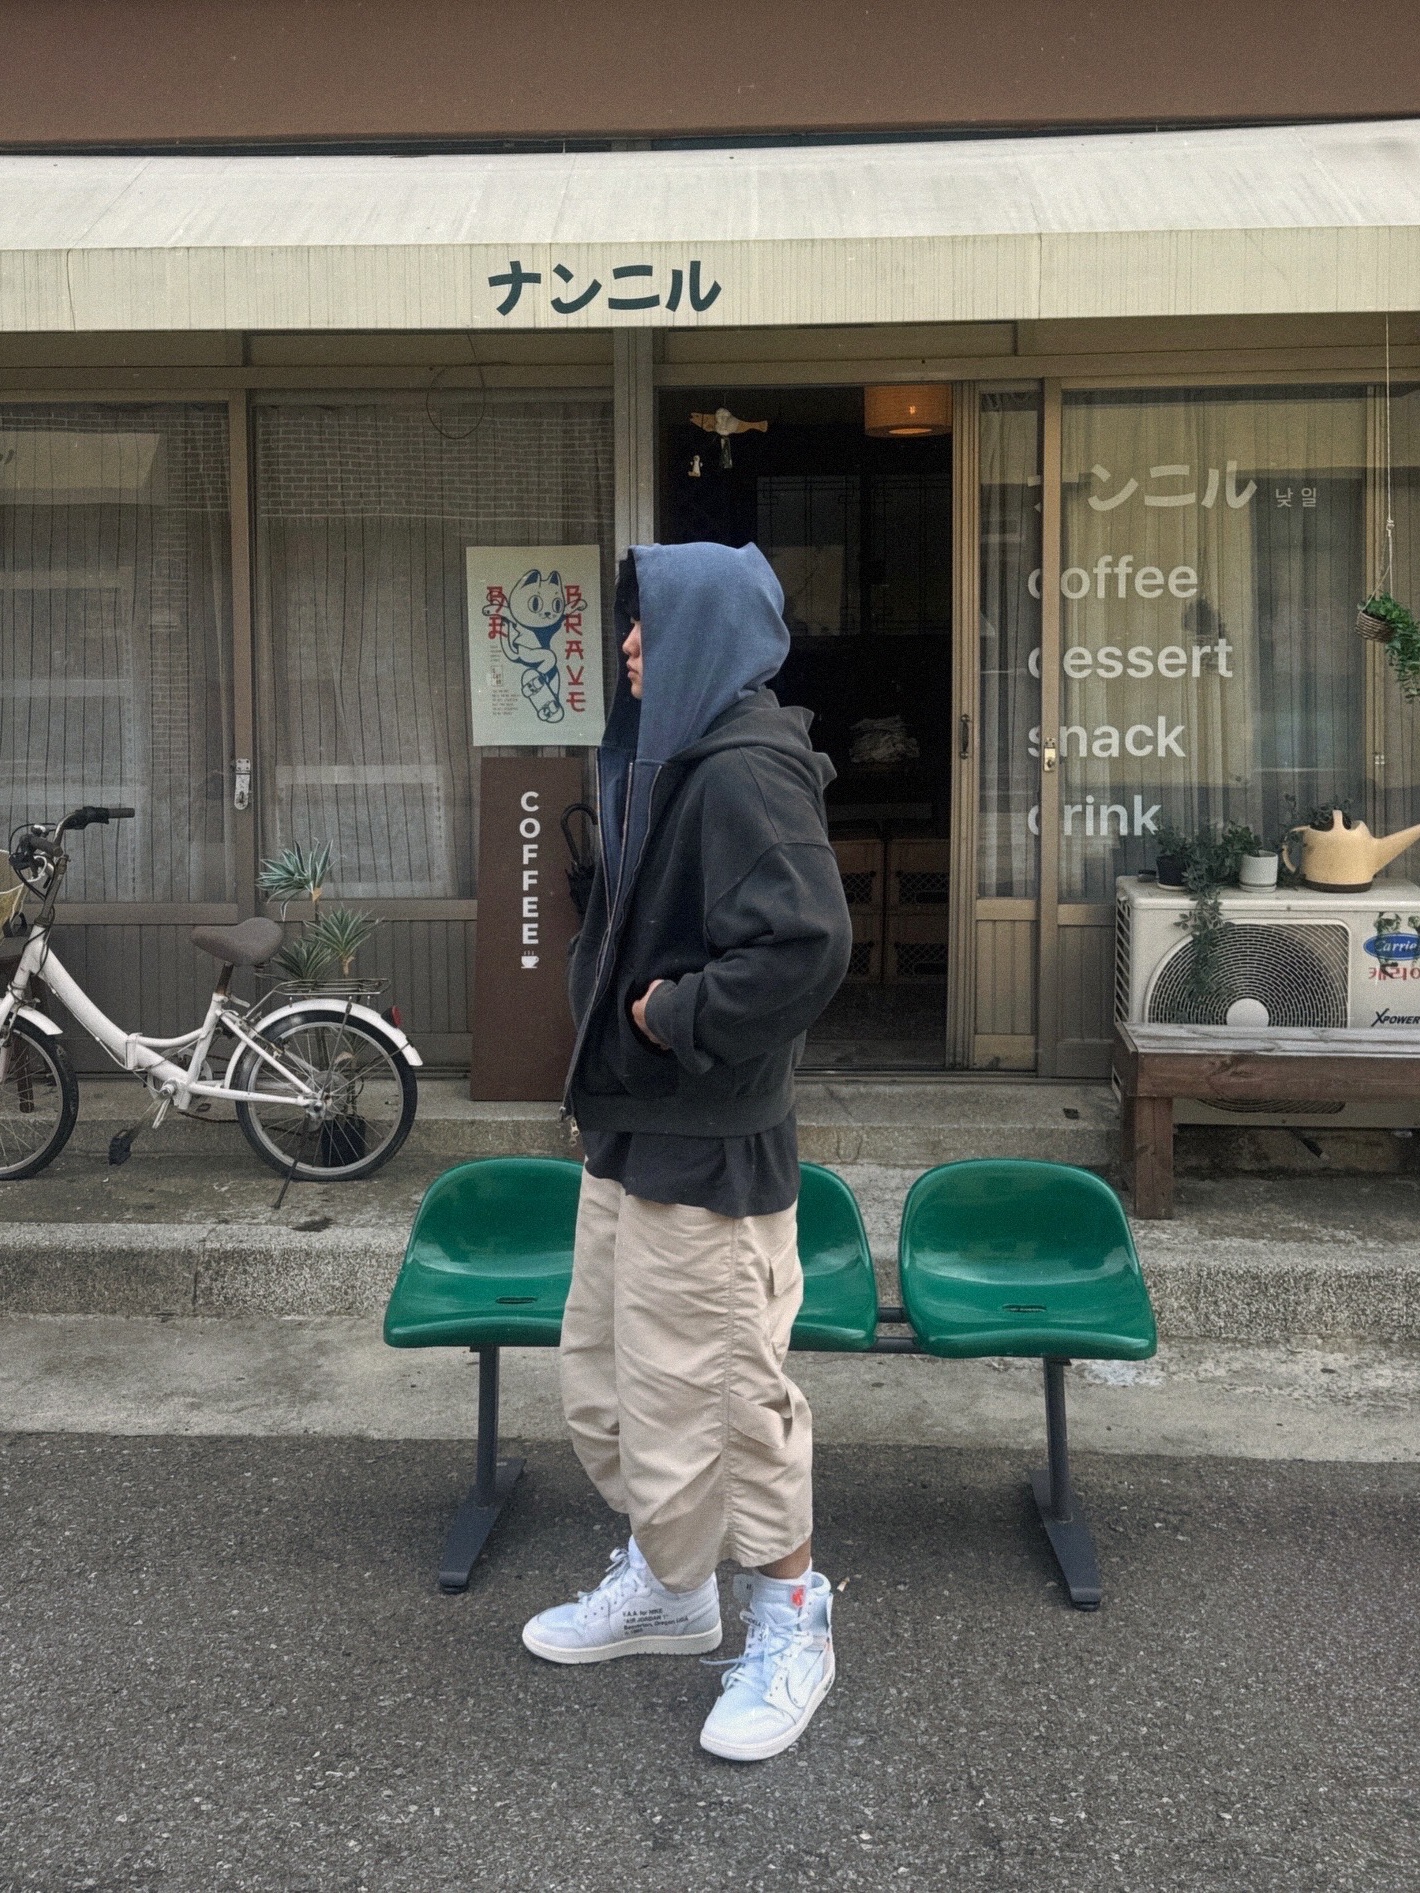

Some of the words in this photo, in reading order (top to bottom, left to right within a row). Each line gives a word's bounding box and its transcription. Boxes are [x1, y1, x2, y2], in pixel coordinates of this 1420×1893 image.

[488, 260, 722, 317] ナンニル
[564, 585, 586, 713] BRAVE
[519, 791, 541, 944] COFFEE
[1375, 939, 1420, 952] Carrie
